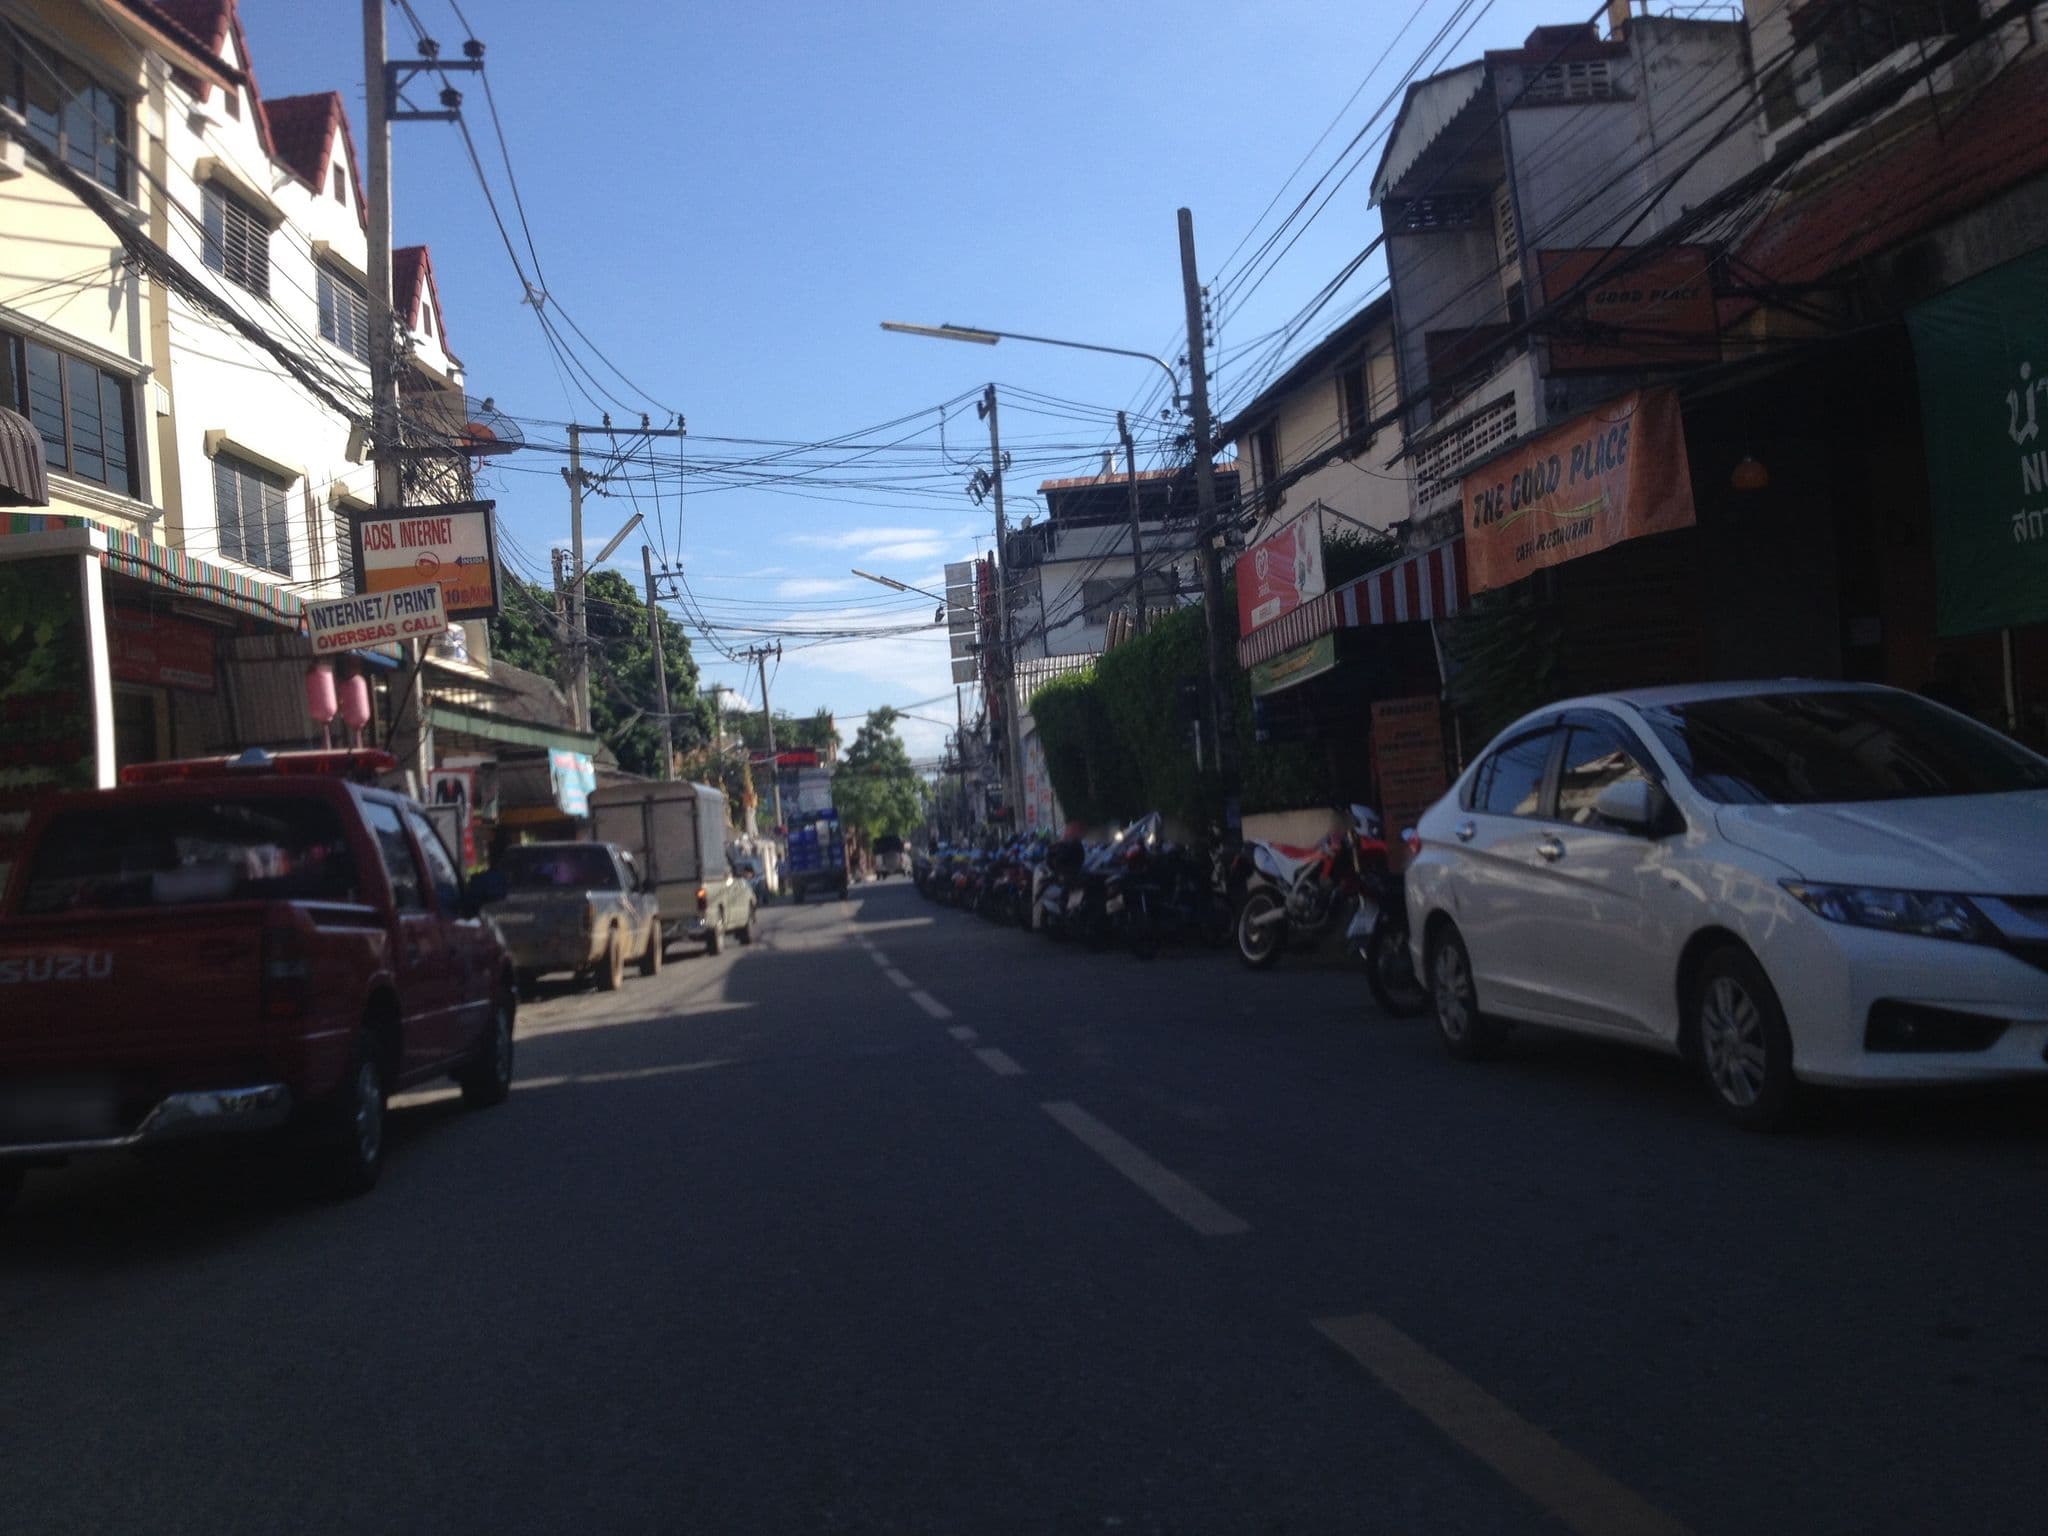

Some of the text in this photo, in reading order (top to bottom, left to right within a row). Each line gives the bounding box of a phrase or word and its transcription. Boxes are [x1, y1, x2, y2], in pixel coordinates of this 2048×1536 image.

[1473, 421, 1631, 530] THE GOOD PLACE
[363, 518, 453, 552] ADSL INTERNET
[317, 615, 441, 650] OVERSEAS CALL
